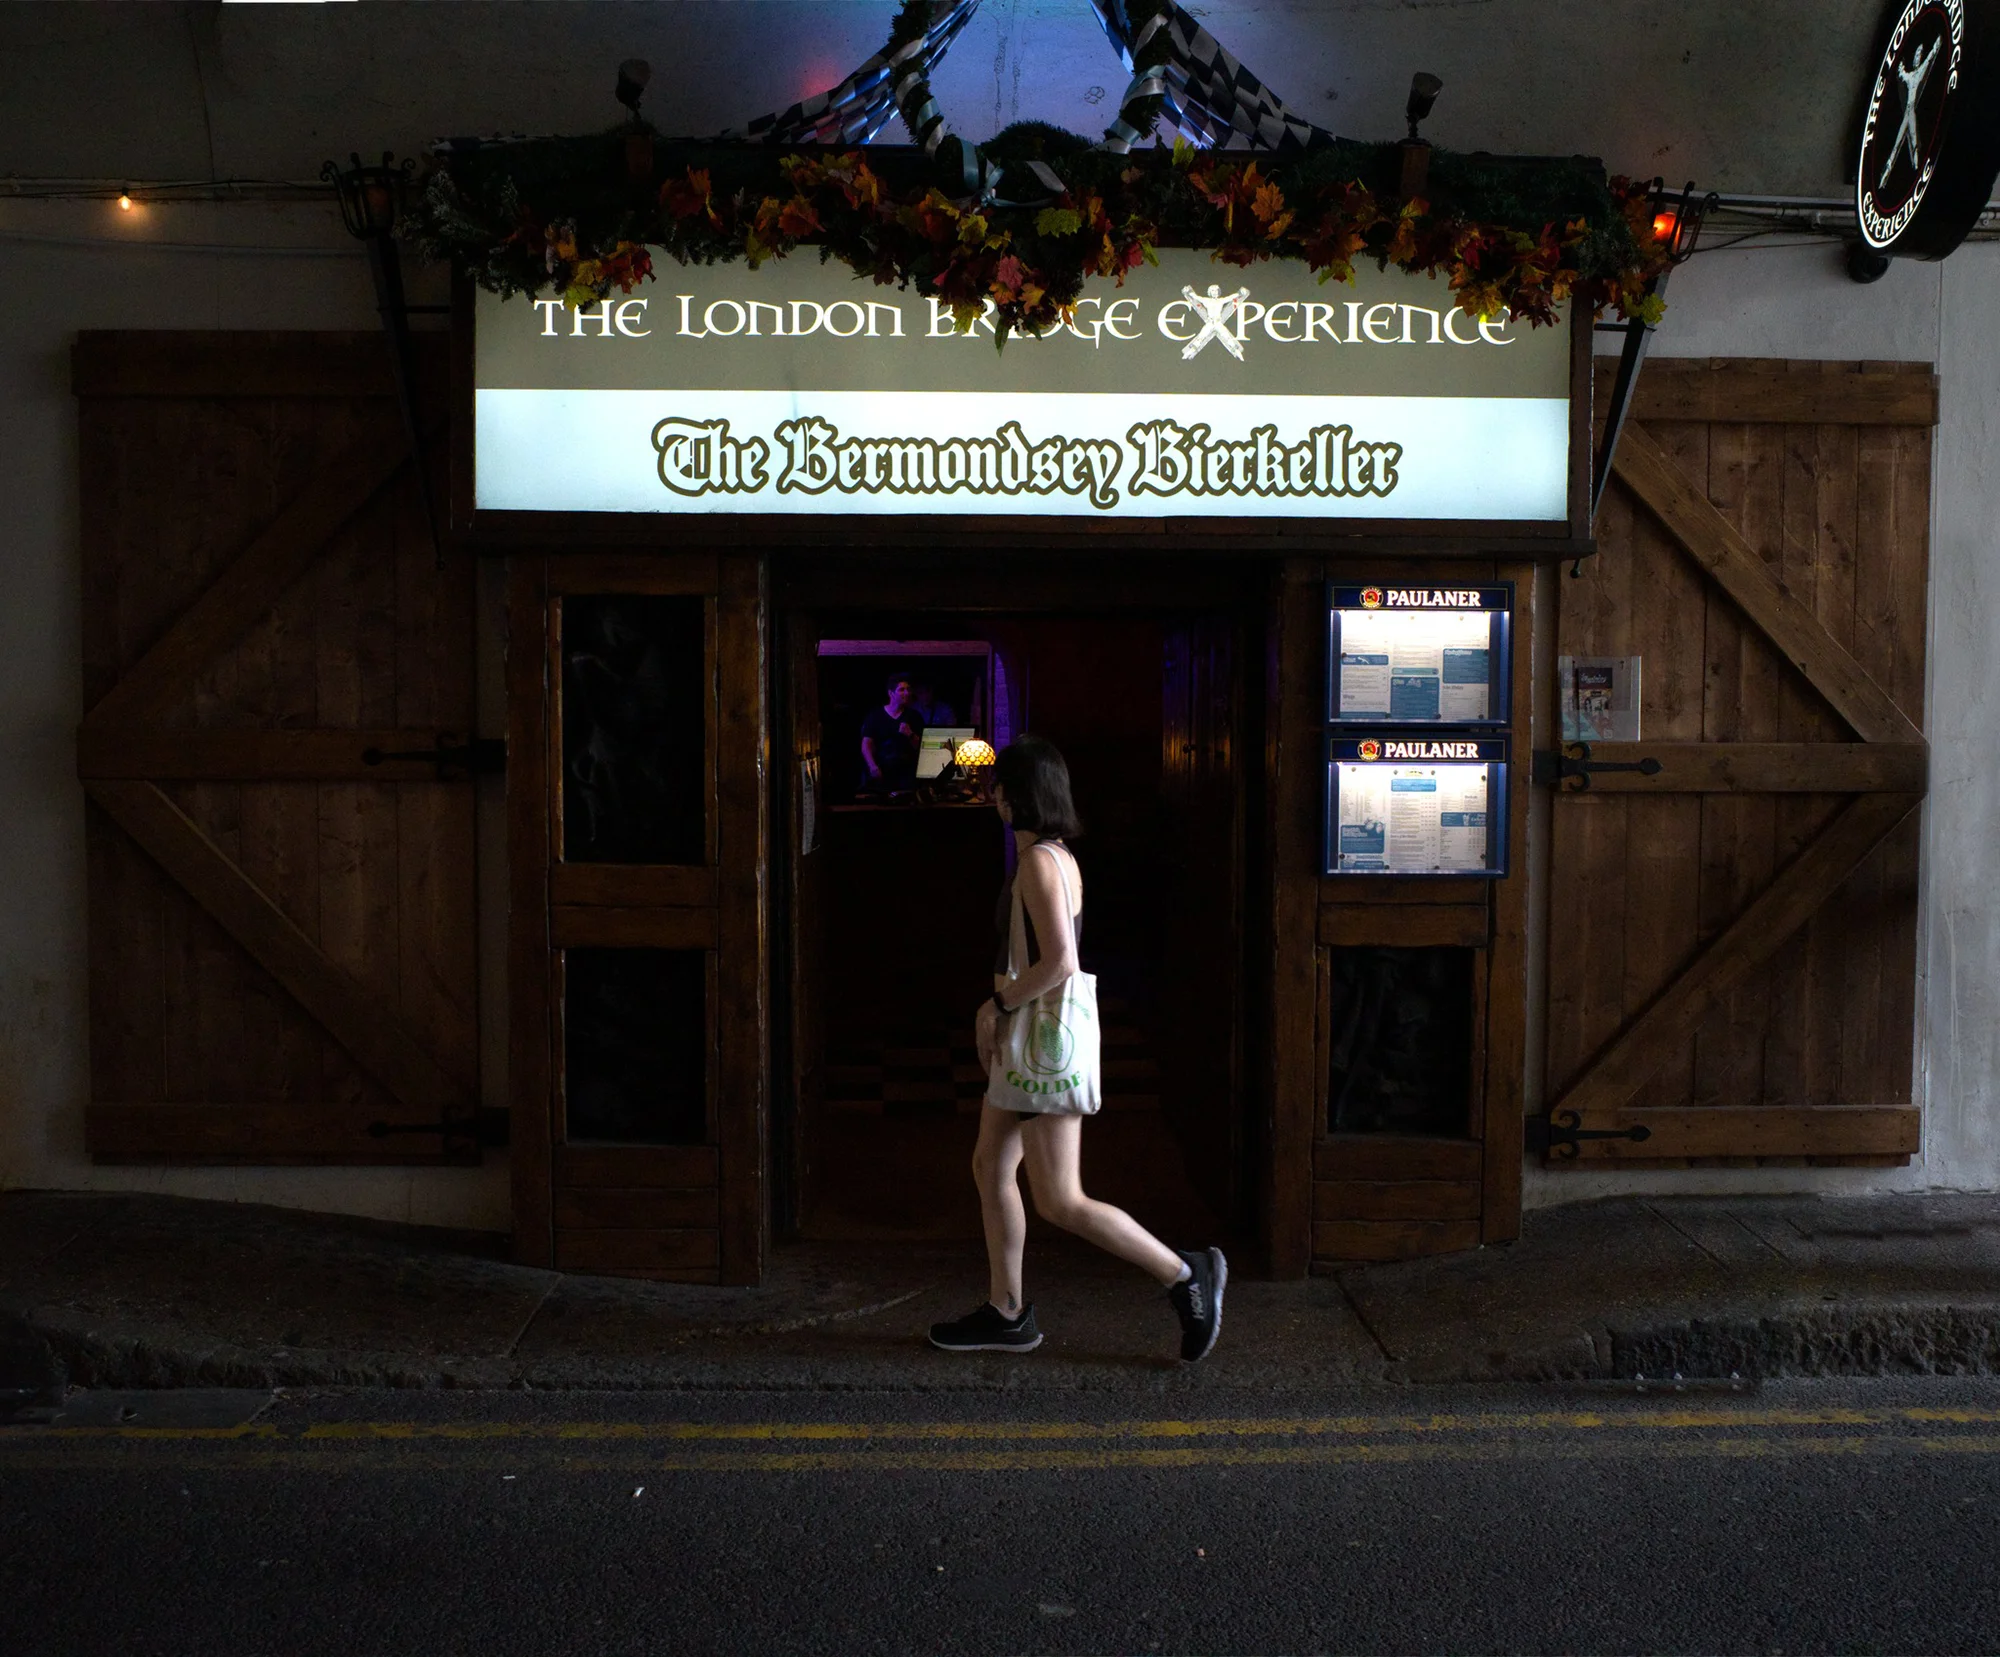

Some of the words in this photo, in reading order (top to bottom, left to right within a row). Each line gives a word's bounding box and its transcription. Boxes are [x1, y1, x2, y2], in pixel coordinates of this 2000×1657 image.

[1864, 76, 1887, 148] THE
[533, 297, 652, 338] THE
[676, 295, 906, 339] LONDON
[651, 416, 771, 497] The
[774, 415, 1124, 510] Bermondsey
[1125, 418, 1404, 498] Bierkeller
[1386, 590, 1481, 607] PAULANER
[1384, 742, 1479, 759] PAULANER
